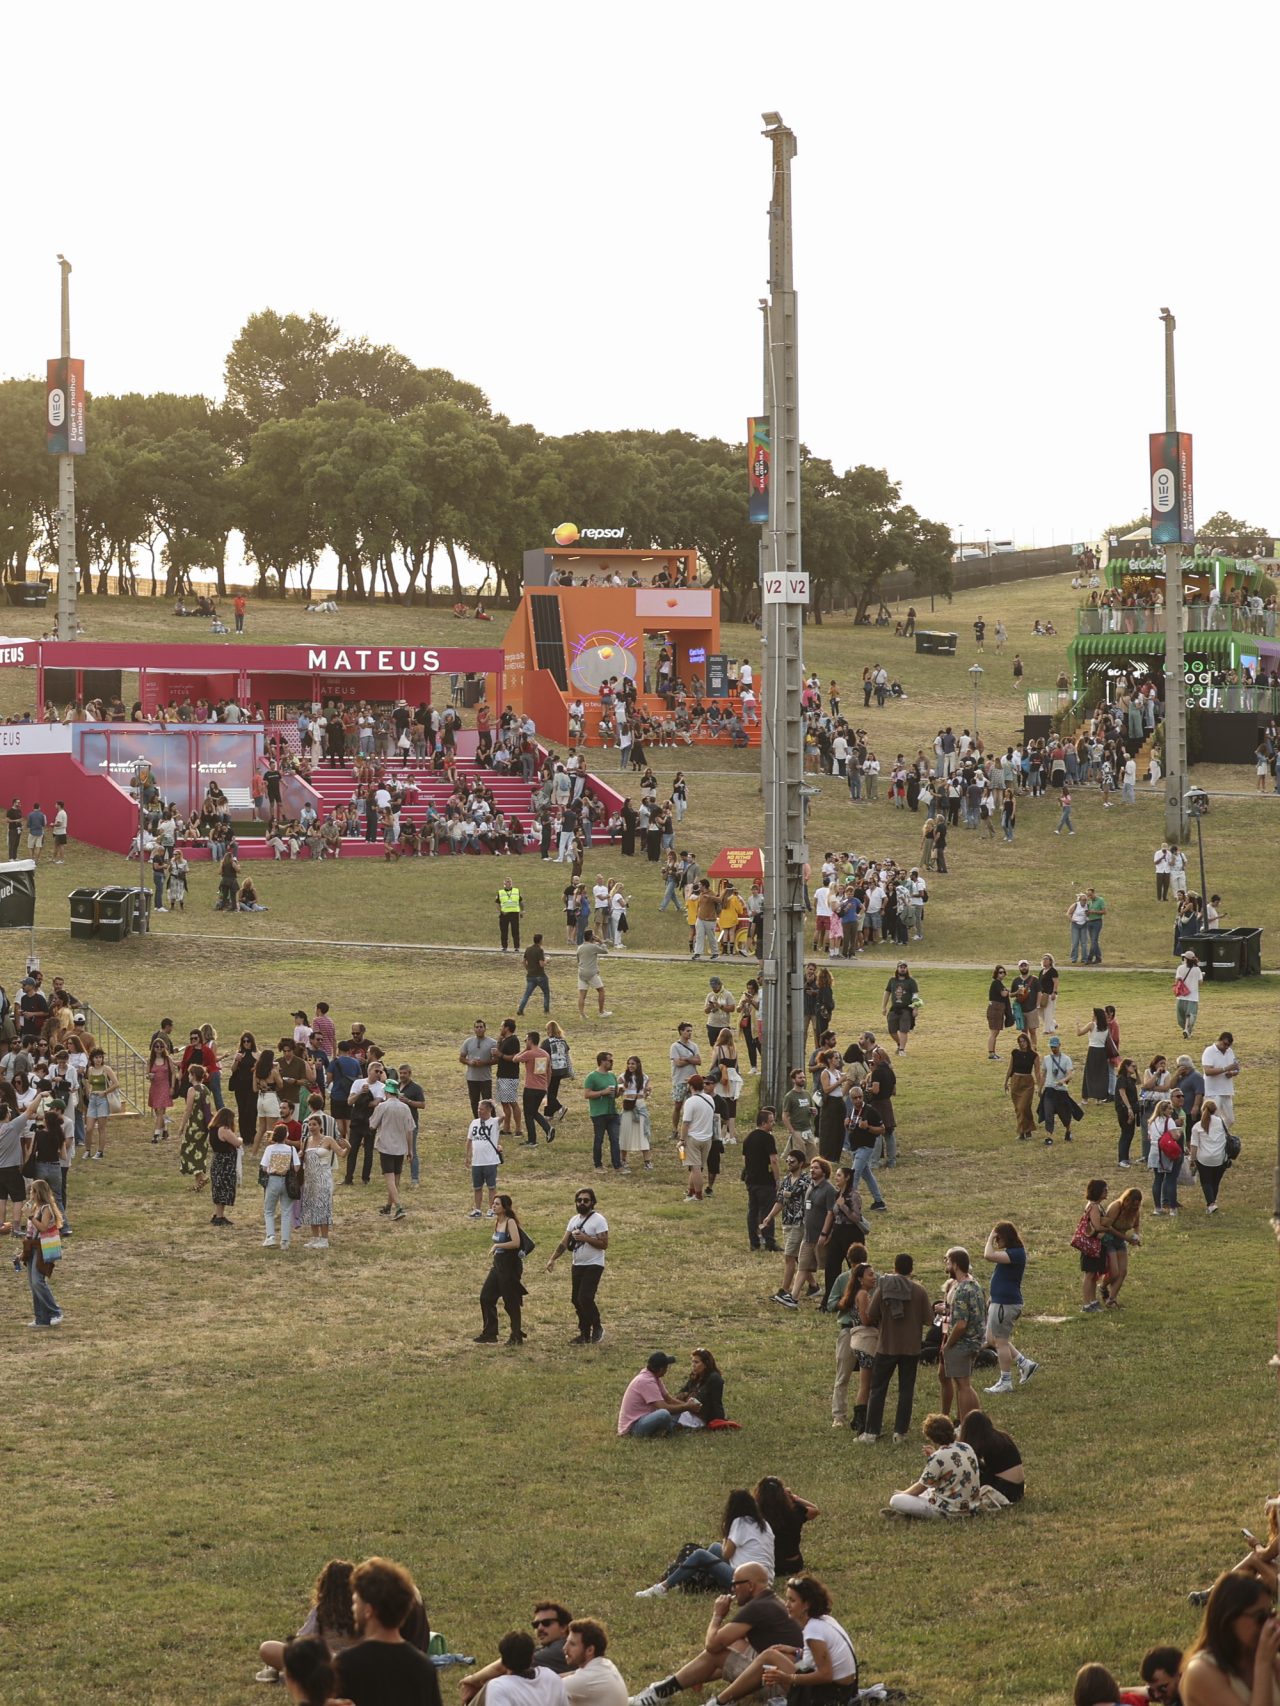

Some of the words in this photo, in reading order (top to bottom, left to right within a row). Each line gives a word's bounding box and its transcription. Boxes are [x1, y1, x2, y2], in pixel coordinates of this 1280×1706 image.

[581, 527, 624, 539] repsol
[766, 579, 782, 594] V2
[789, 579, 806, 594] V2
[308, 649, 440, 671] MATEUS
[320, 686, 356, 695] ATEUS
